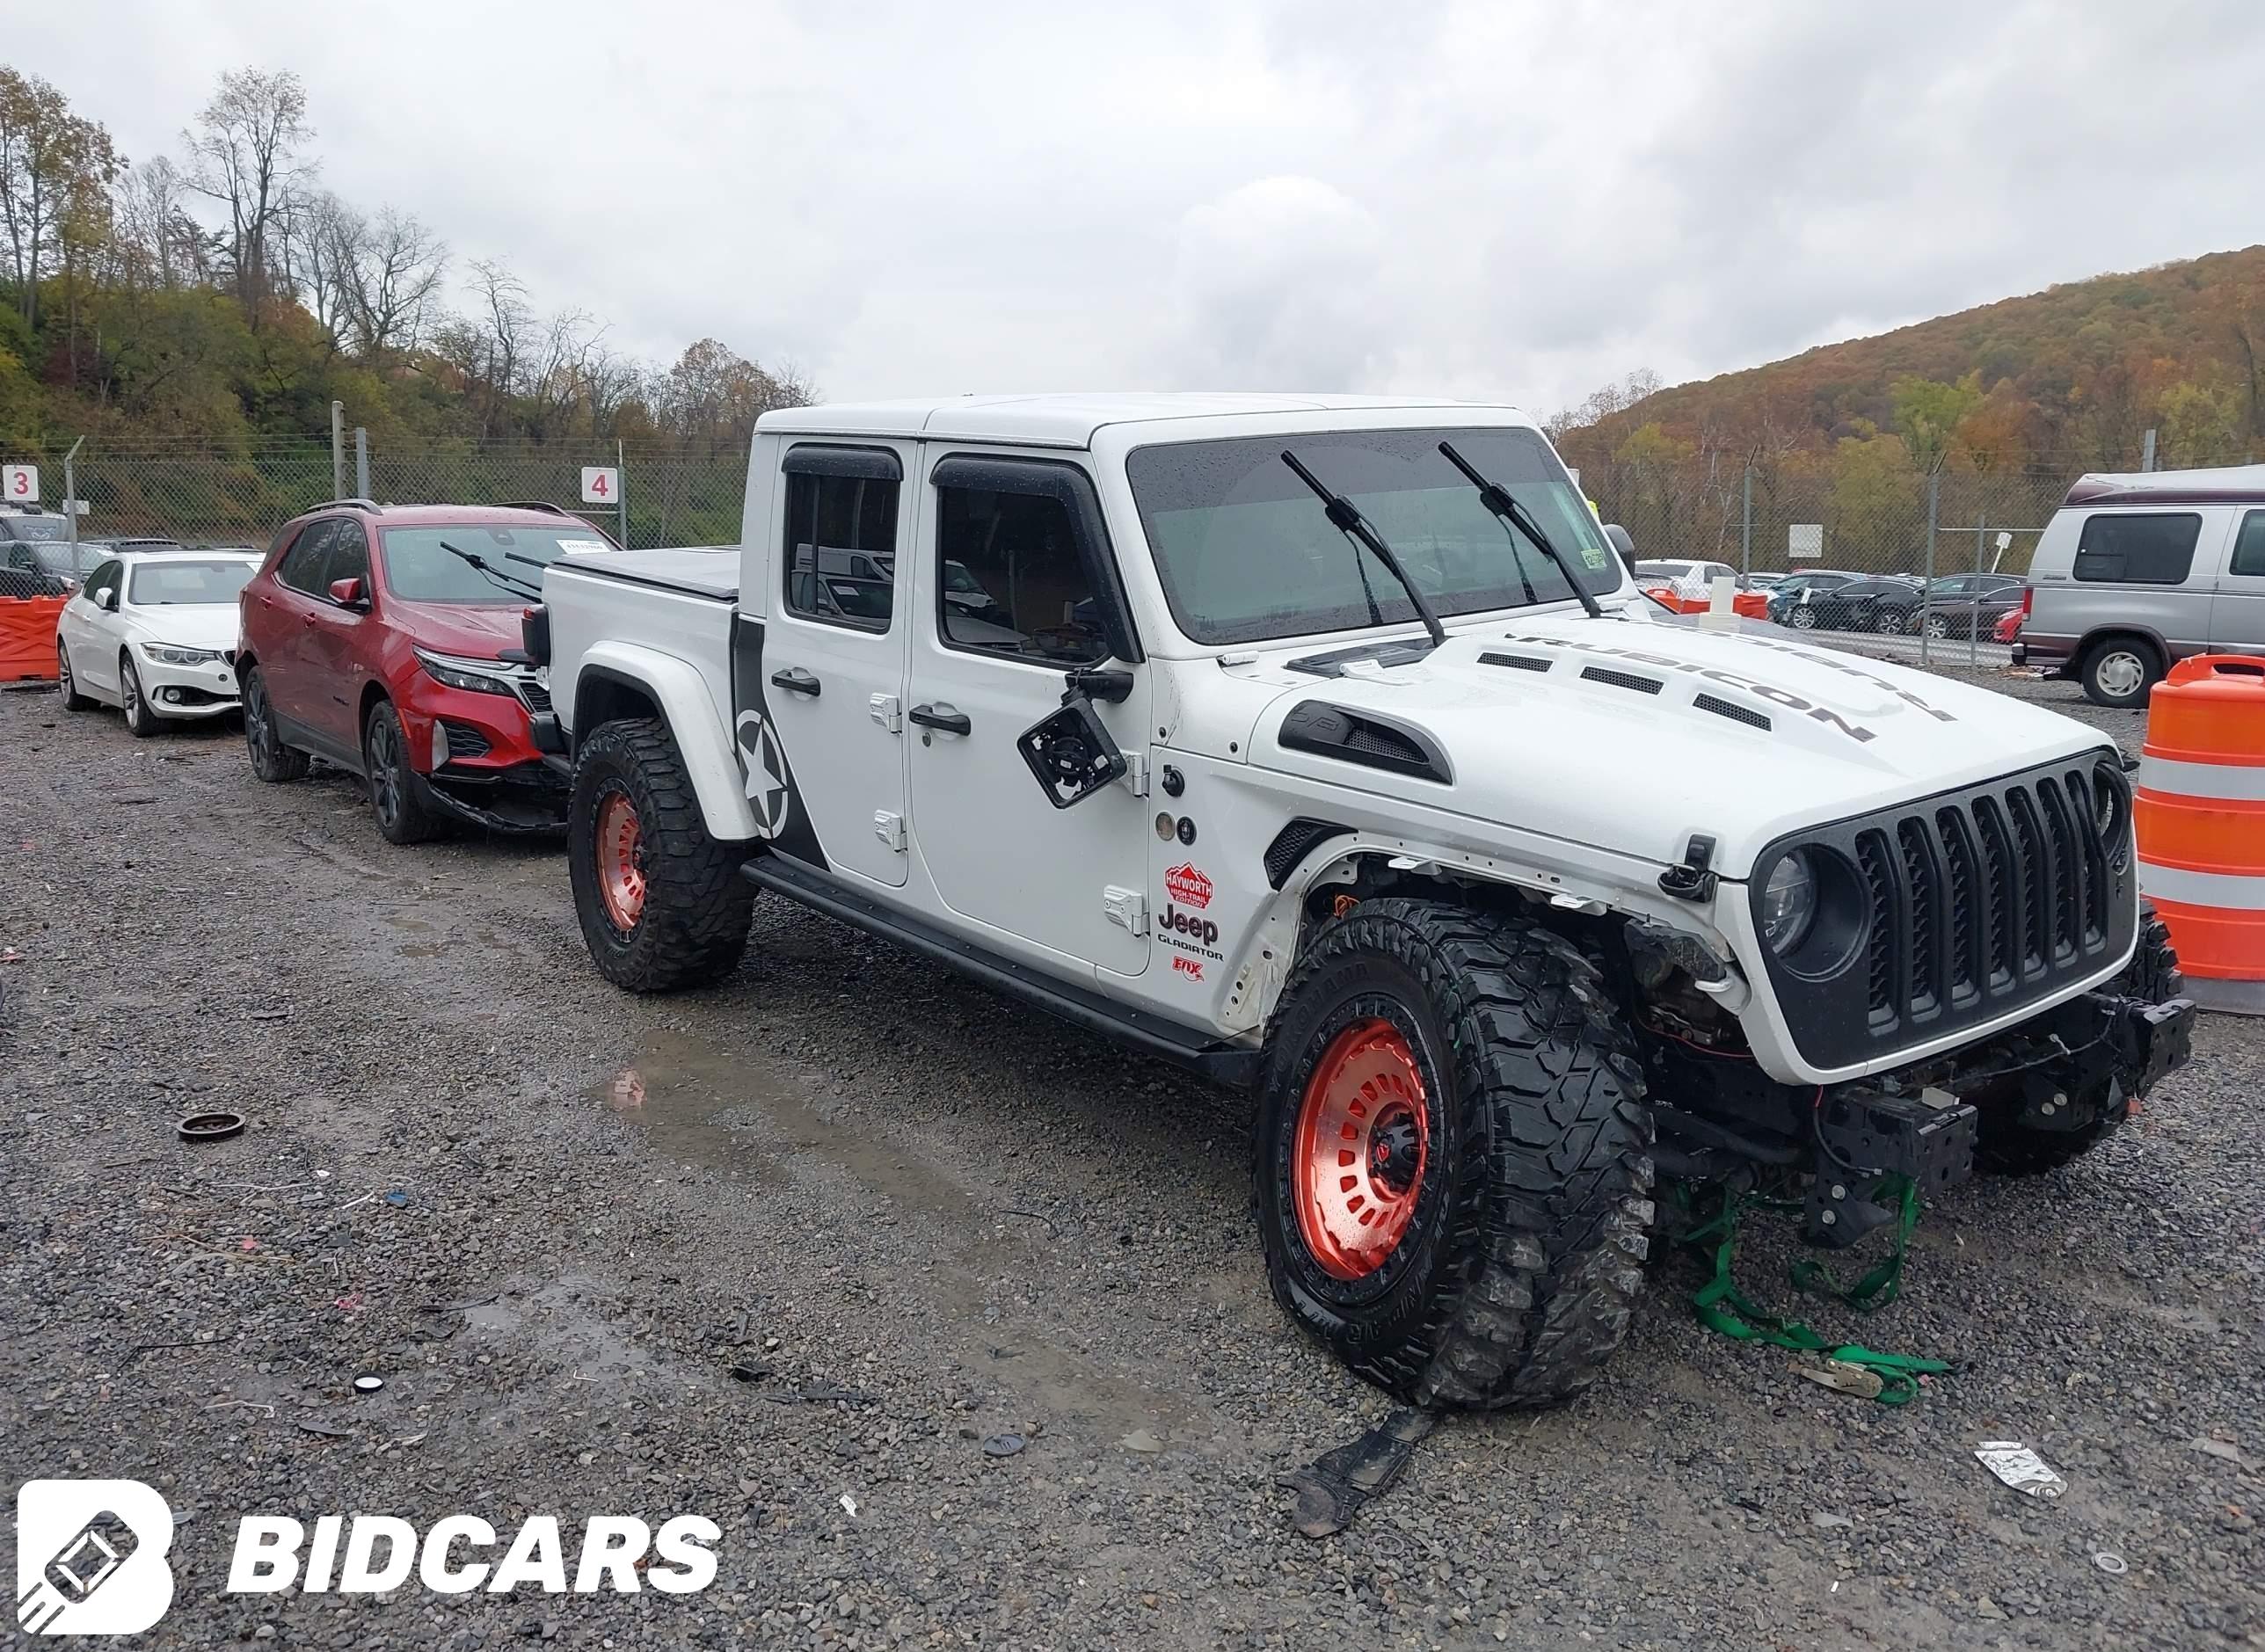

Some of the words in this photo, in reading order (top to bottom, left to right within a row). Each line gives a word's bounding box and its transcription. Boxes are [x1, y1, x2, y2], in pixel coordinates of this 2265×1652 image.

[13, 471, 29, 495] 3
[591, 474, 608, 497] 4
[1515, 637, 1878, 743] RUBICON
[1166, 872, 1213, 897] HAYWORTH
[1170, 888, 1207, 904] HIGH-TRAIL
[1175, 895, 1204, 908] EDITION
[1158, 902, 1219, 947] Jeep
[1157, 934, 1225, 962] GLADIATOR
[1172, 956, 1203, 976] FOX
